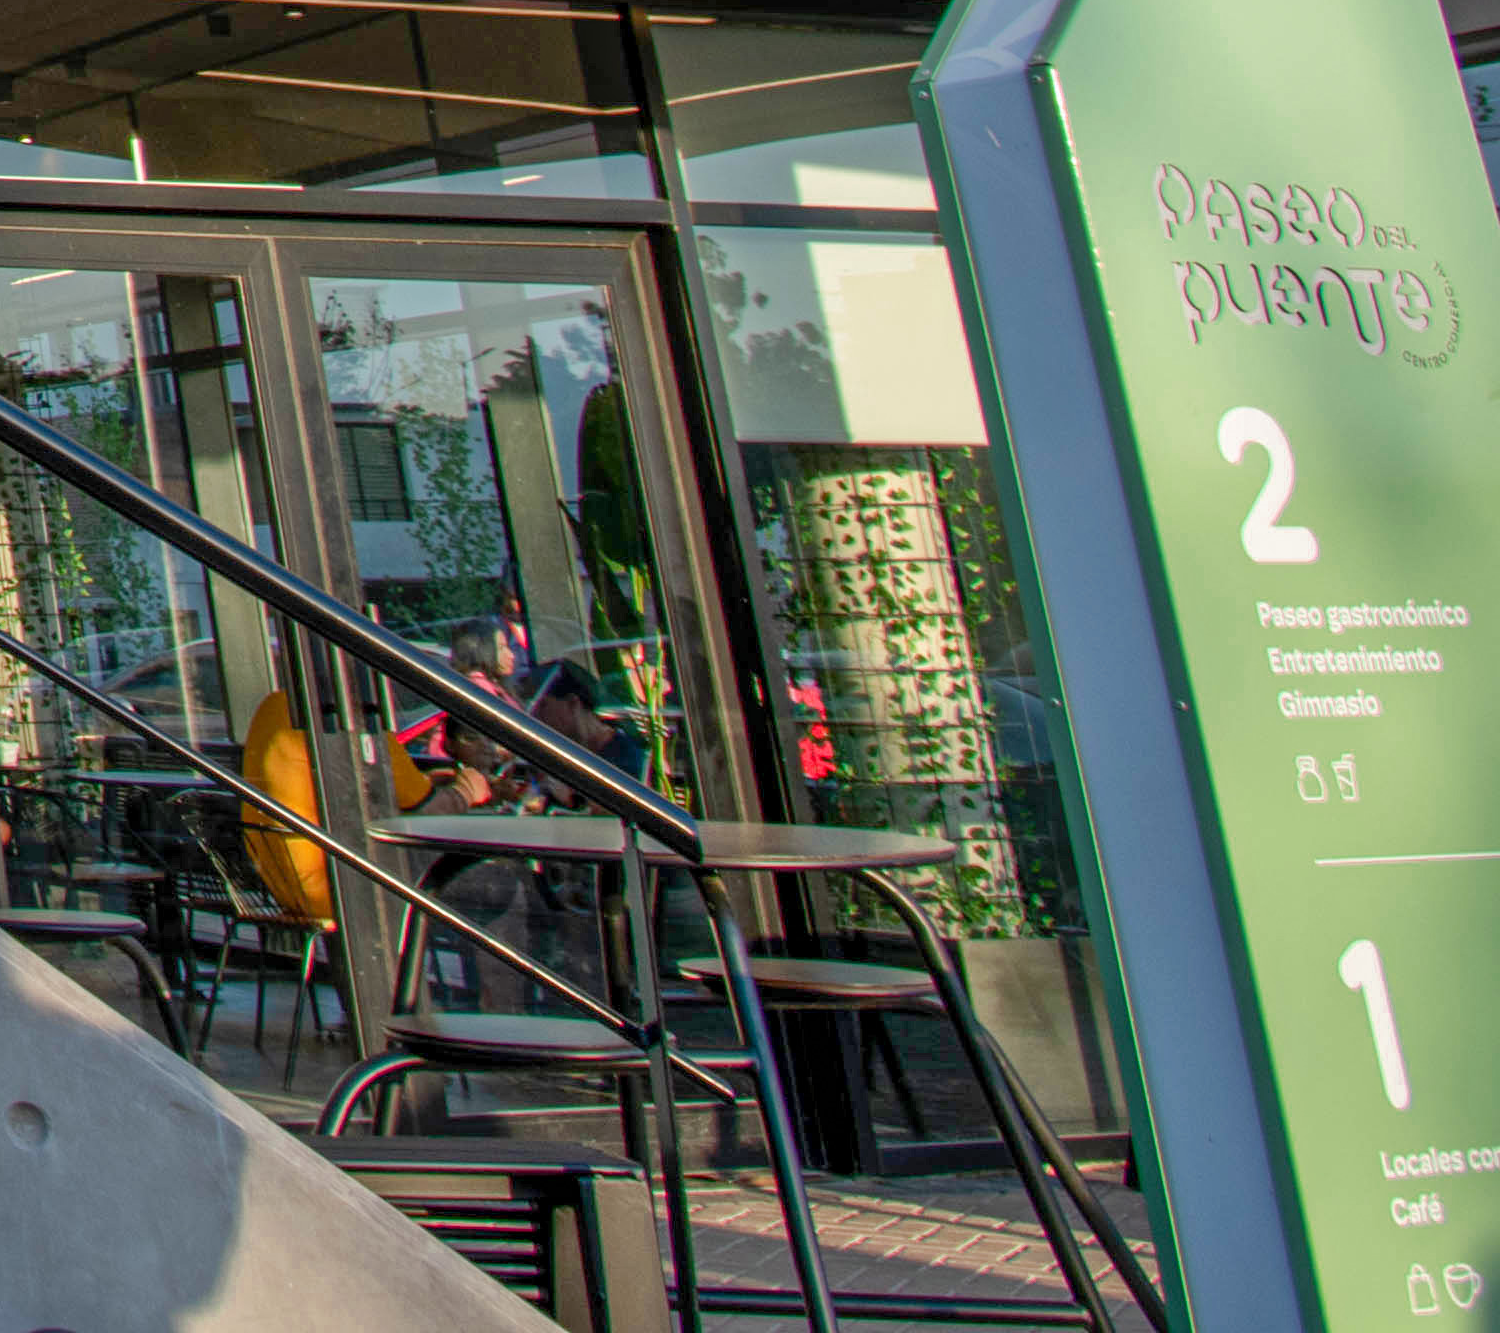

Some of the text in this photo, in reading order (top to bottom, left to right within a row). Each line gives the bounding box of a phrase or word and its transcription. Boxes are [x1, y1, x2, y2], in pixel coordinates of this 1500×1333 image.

[1218, 406, 1320, 564] 2
[1256, 598, 1470, 634] Paseo gastronómico
[1267, 644, 1444, 674] Entretenimiento
[1277, 688, 1381, 718] Gimnasio
[1338, 939, 1411, 1110] 1
[1379, 1146, 1468, 1180] Locales
[1390, 1191, 1446, 1228] Café
